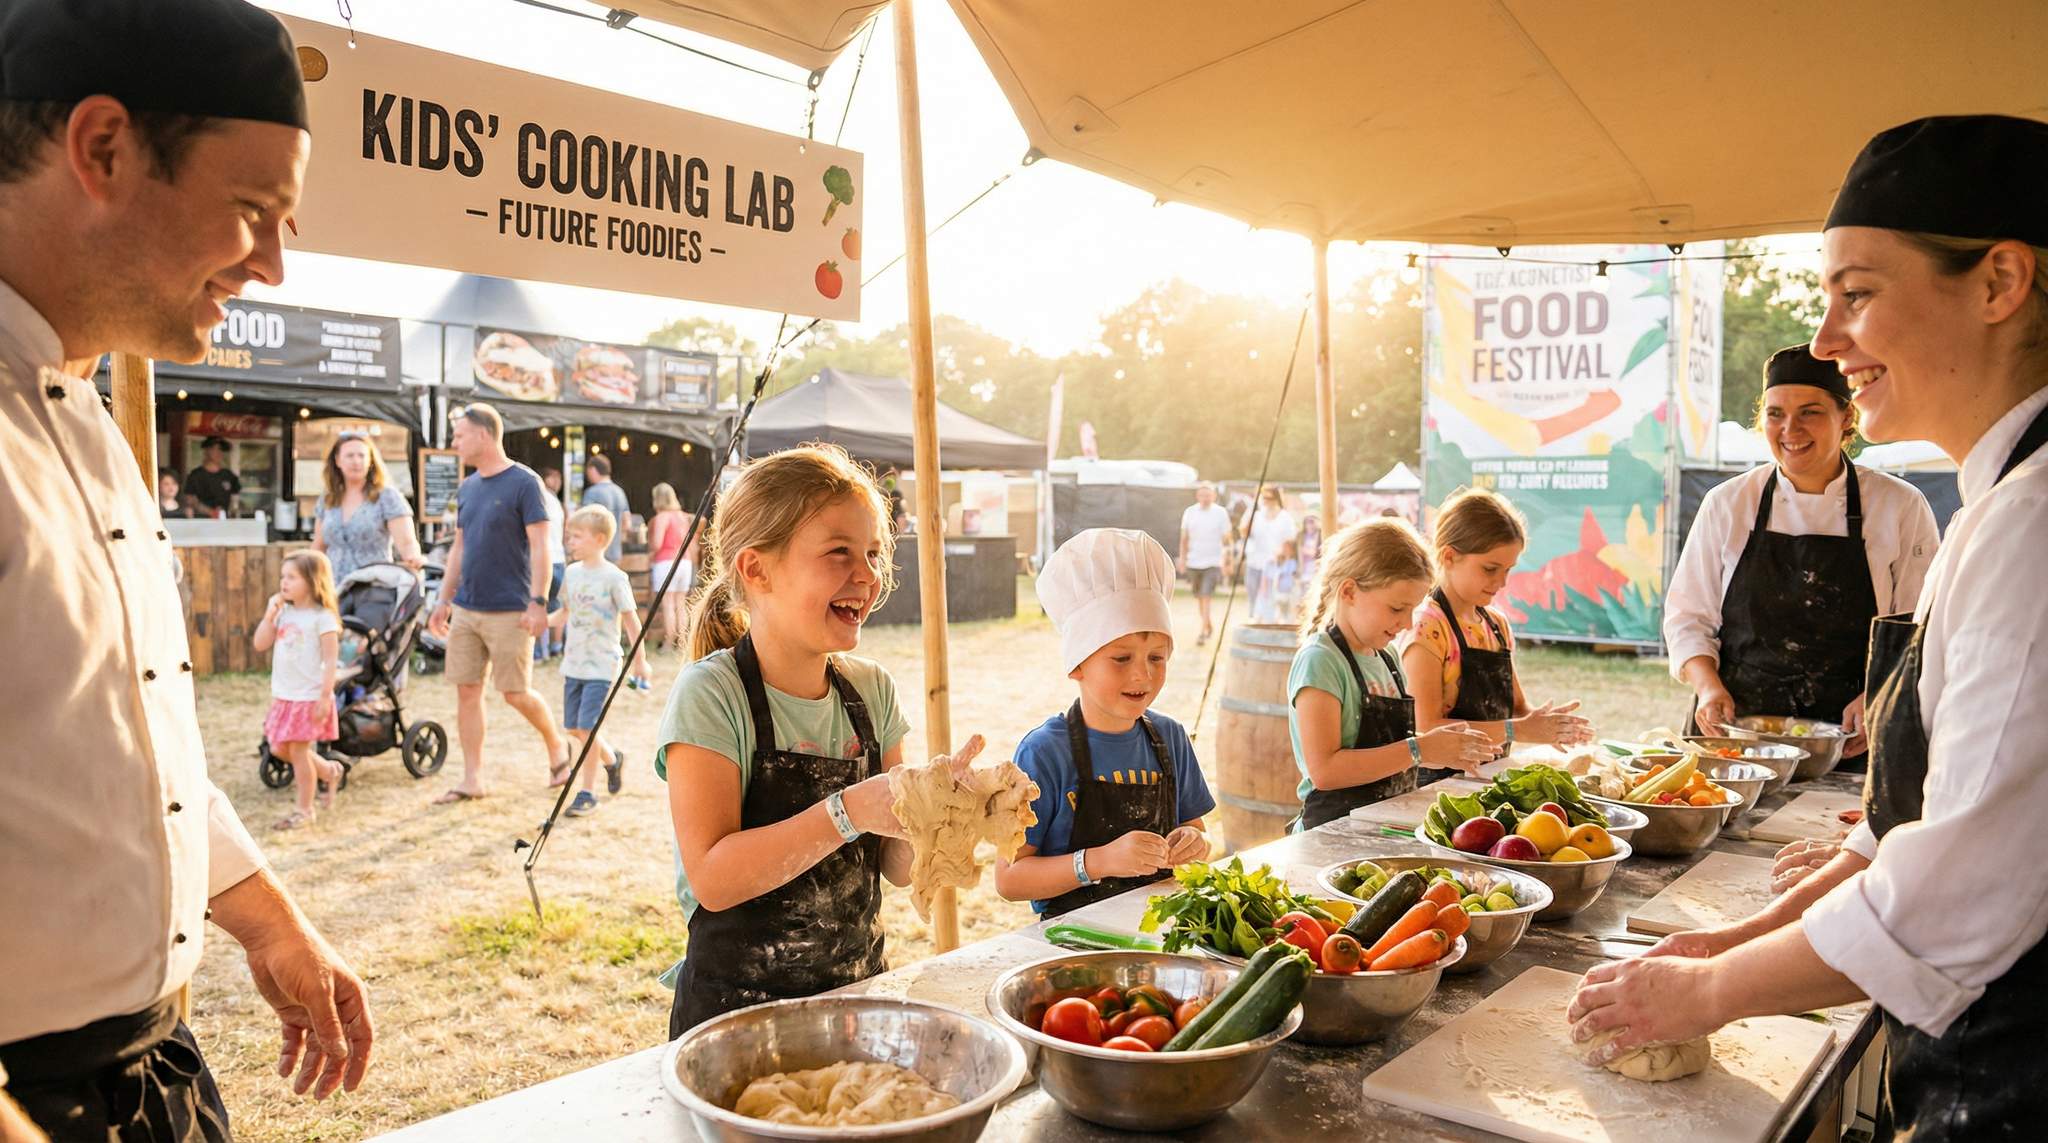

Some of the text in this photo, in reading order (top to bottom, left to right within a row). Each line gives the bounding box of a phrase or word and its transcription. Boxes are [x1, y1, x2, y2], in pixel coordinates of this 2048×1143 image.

[362, 88, 795, 233] KIDS’ COOKING LAB
[499, 198, 702, 264] FUTURE FOODIES
[213, 308, 286, 348] FOOD
[1473, 291, 1609, 341] FOOD
[1472, 343, 1611, 383] FESTIVAL
